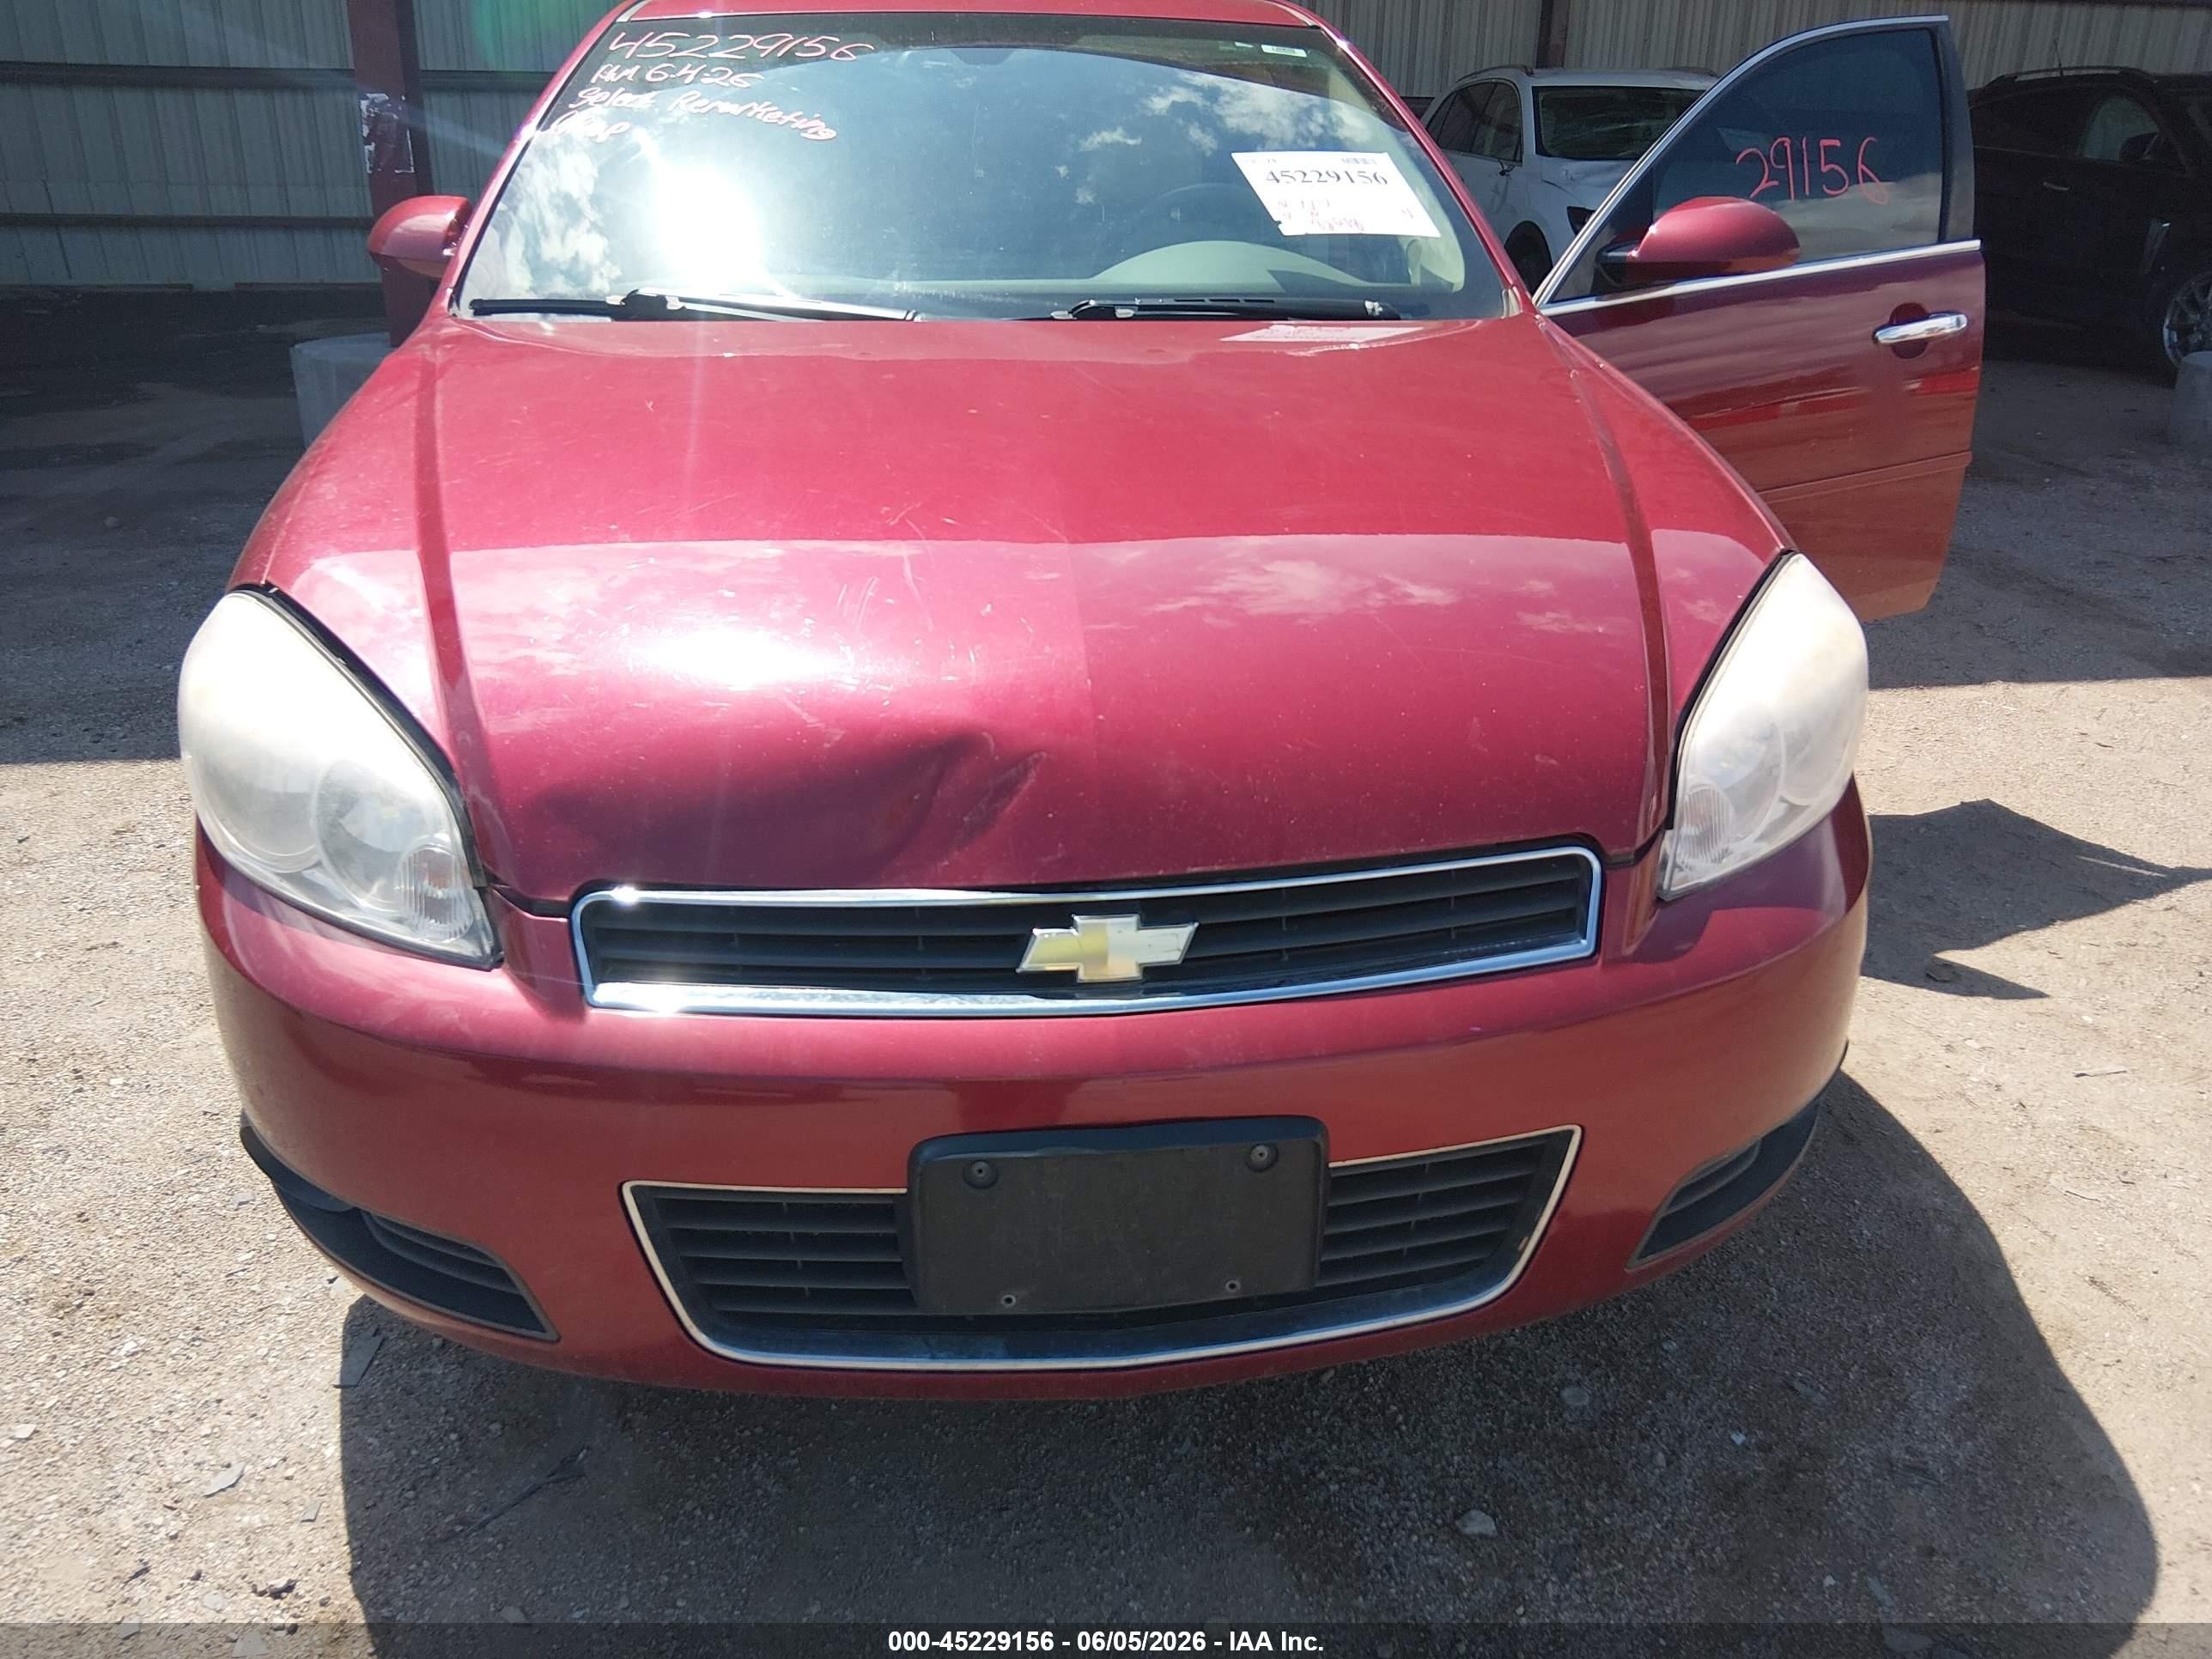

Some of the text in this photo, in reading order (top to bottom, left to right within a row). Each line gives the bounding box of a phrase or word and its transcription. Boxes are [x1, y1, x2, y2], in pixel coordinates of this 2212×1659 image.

[609, 31, 874, 62] 45229156
[1265, 169, 1389, 186] 45229156
[1735, 137, 1888, 205] 29156
